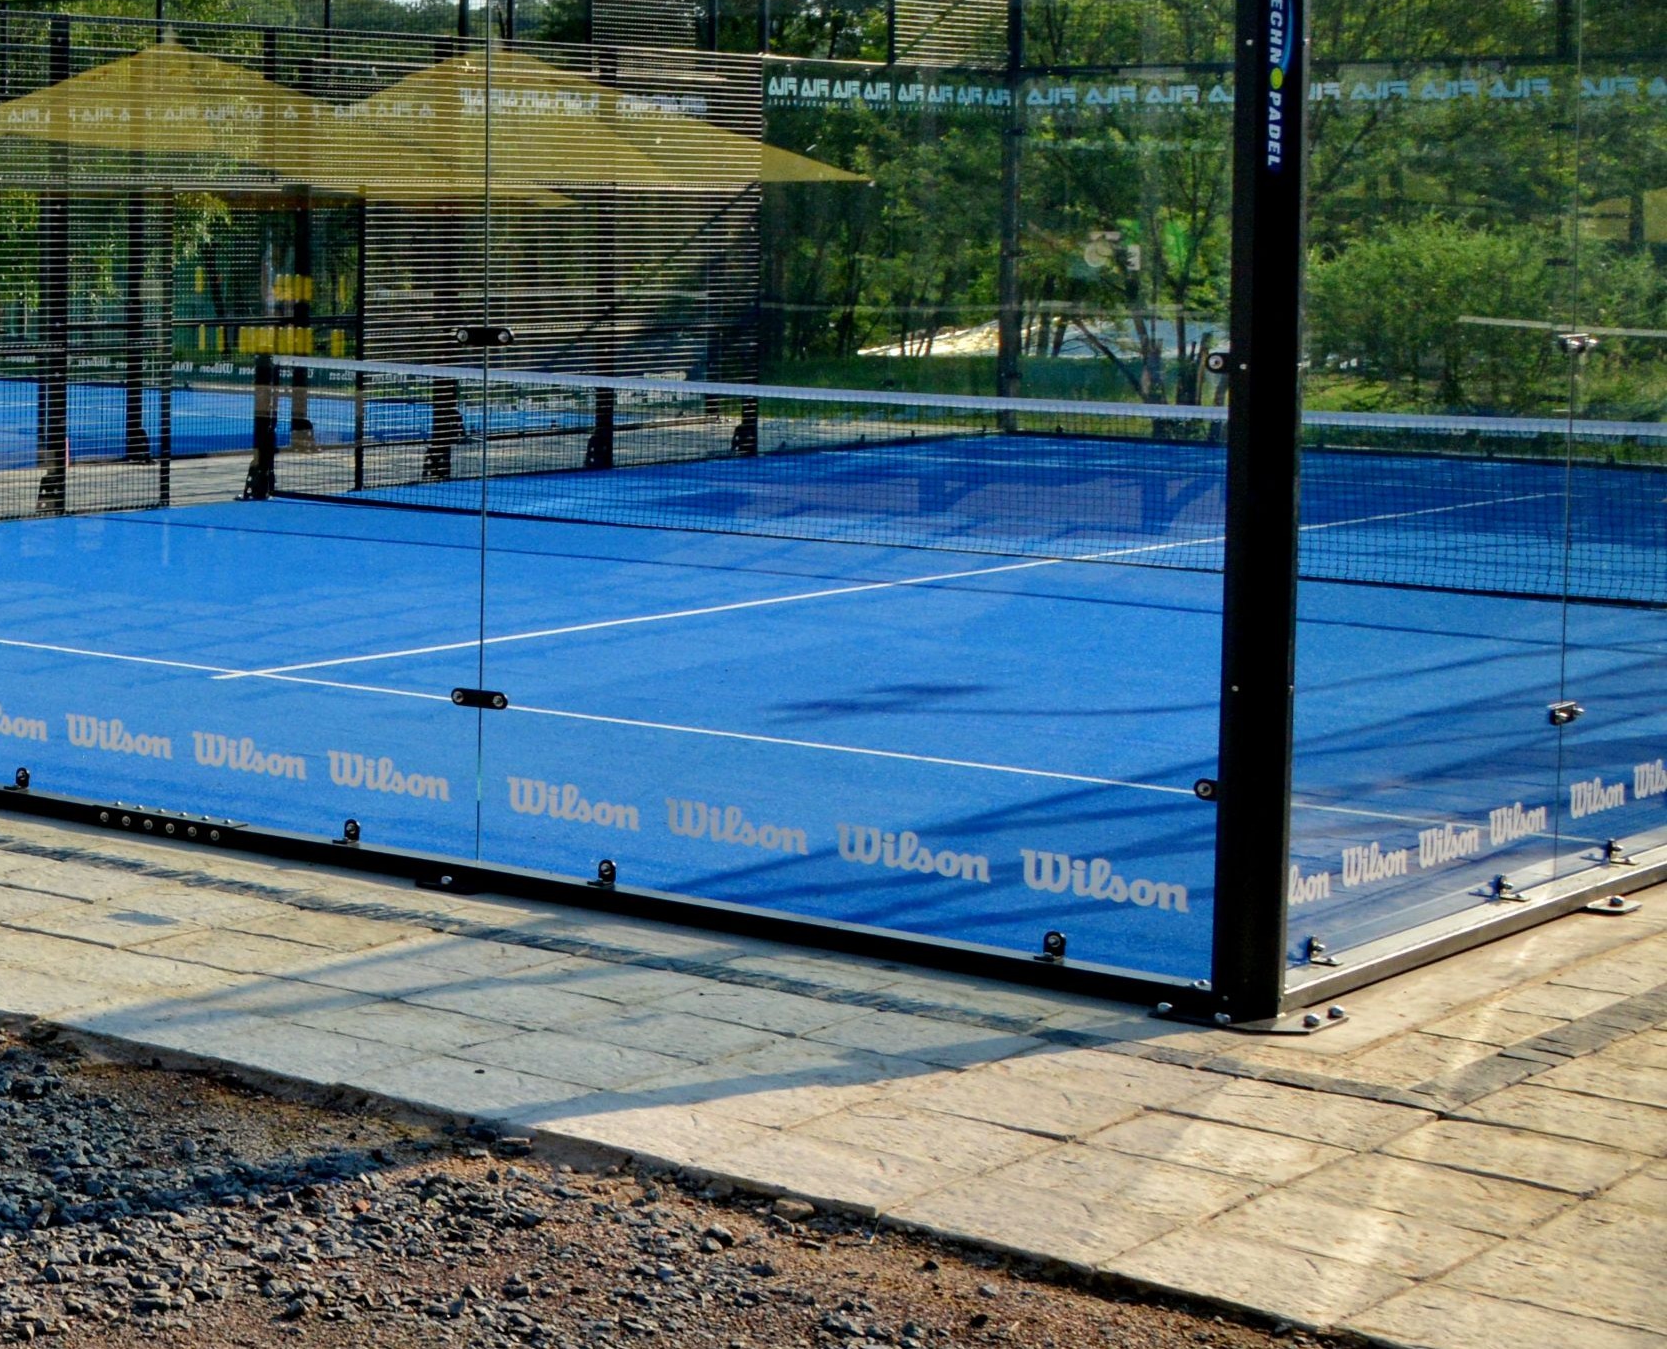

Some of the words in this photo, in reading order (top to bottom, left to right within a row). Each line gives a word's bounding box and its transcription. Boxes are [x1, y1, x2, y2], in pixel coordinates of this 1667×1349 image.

[66, 712, 172, 761] Wilson
[192, 730, 307, 782] Wilson
[327, 749, 450, 802] Wilson
[507, 775, 640, 832] Wilson
[667, 796, 808, 856] Wilson
[836, 821, 991, 884] Wilson
[1020, 847, 1190, 913] Wilson
[1288, 864, 1330, 906] lson
[1342, 842, 1407, 888] Wilson
[1418, 822, 1479, 869] Wilson
[1489, 802, 1546, 847] Wilson
[1570, 776, 1625, 819] Wilson
